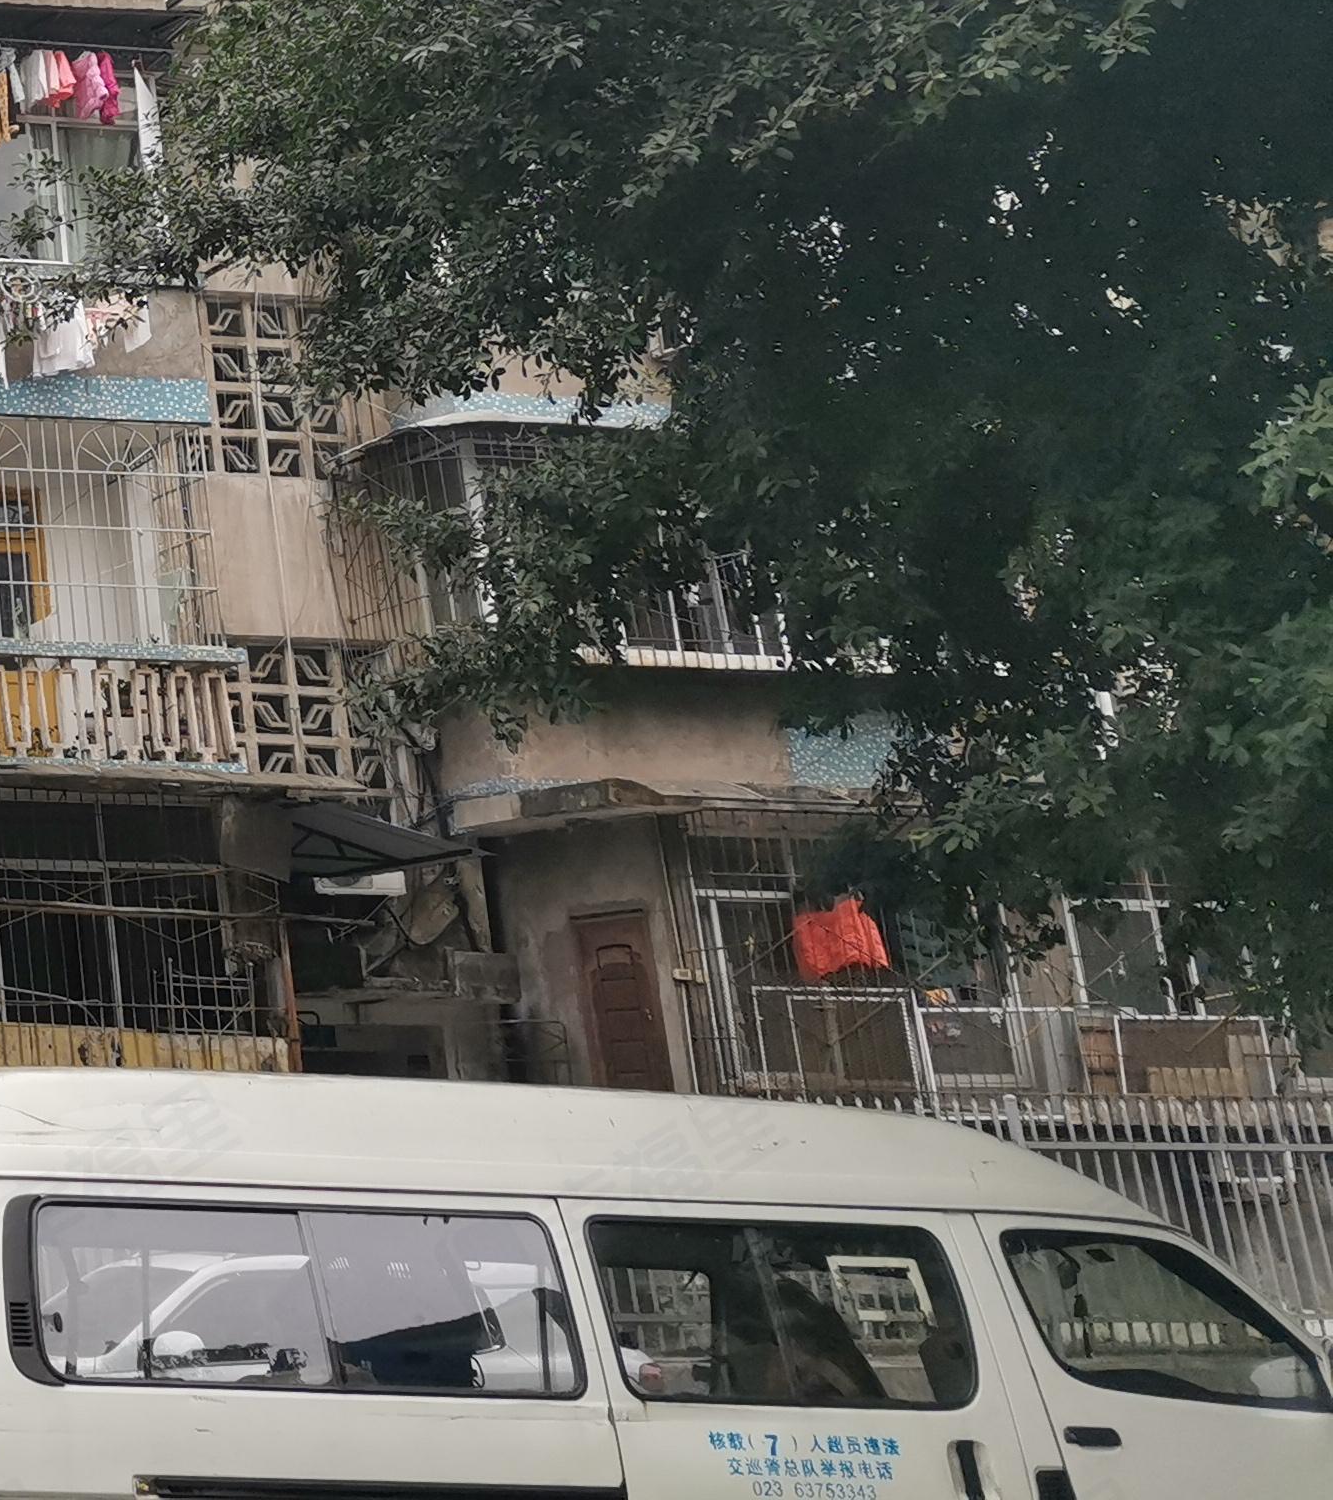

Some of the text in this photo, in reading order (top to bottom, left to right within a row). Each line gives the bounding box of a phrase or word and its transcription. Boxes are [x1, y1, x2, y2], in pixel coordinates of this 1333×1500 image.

[727, 1457, 894, 1480] 交巡警总队举报电话
[752, 1480, 878, 1500] 023 63753343
